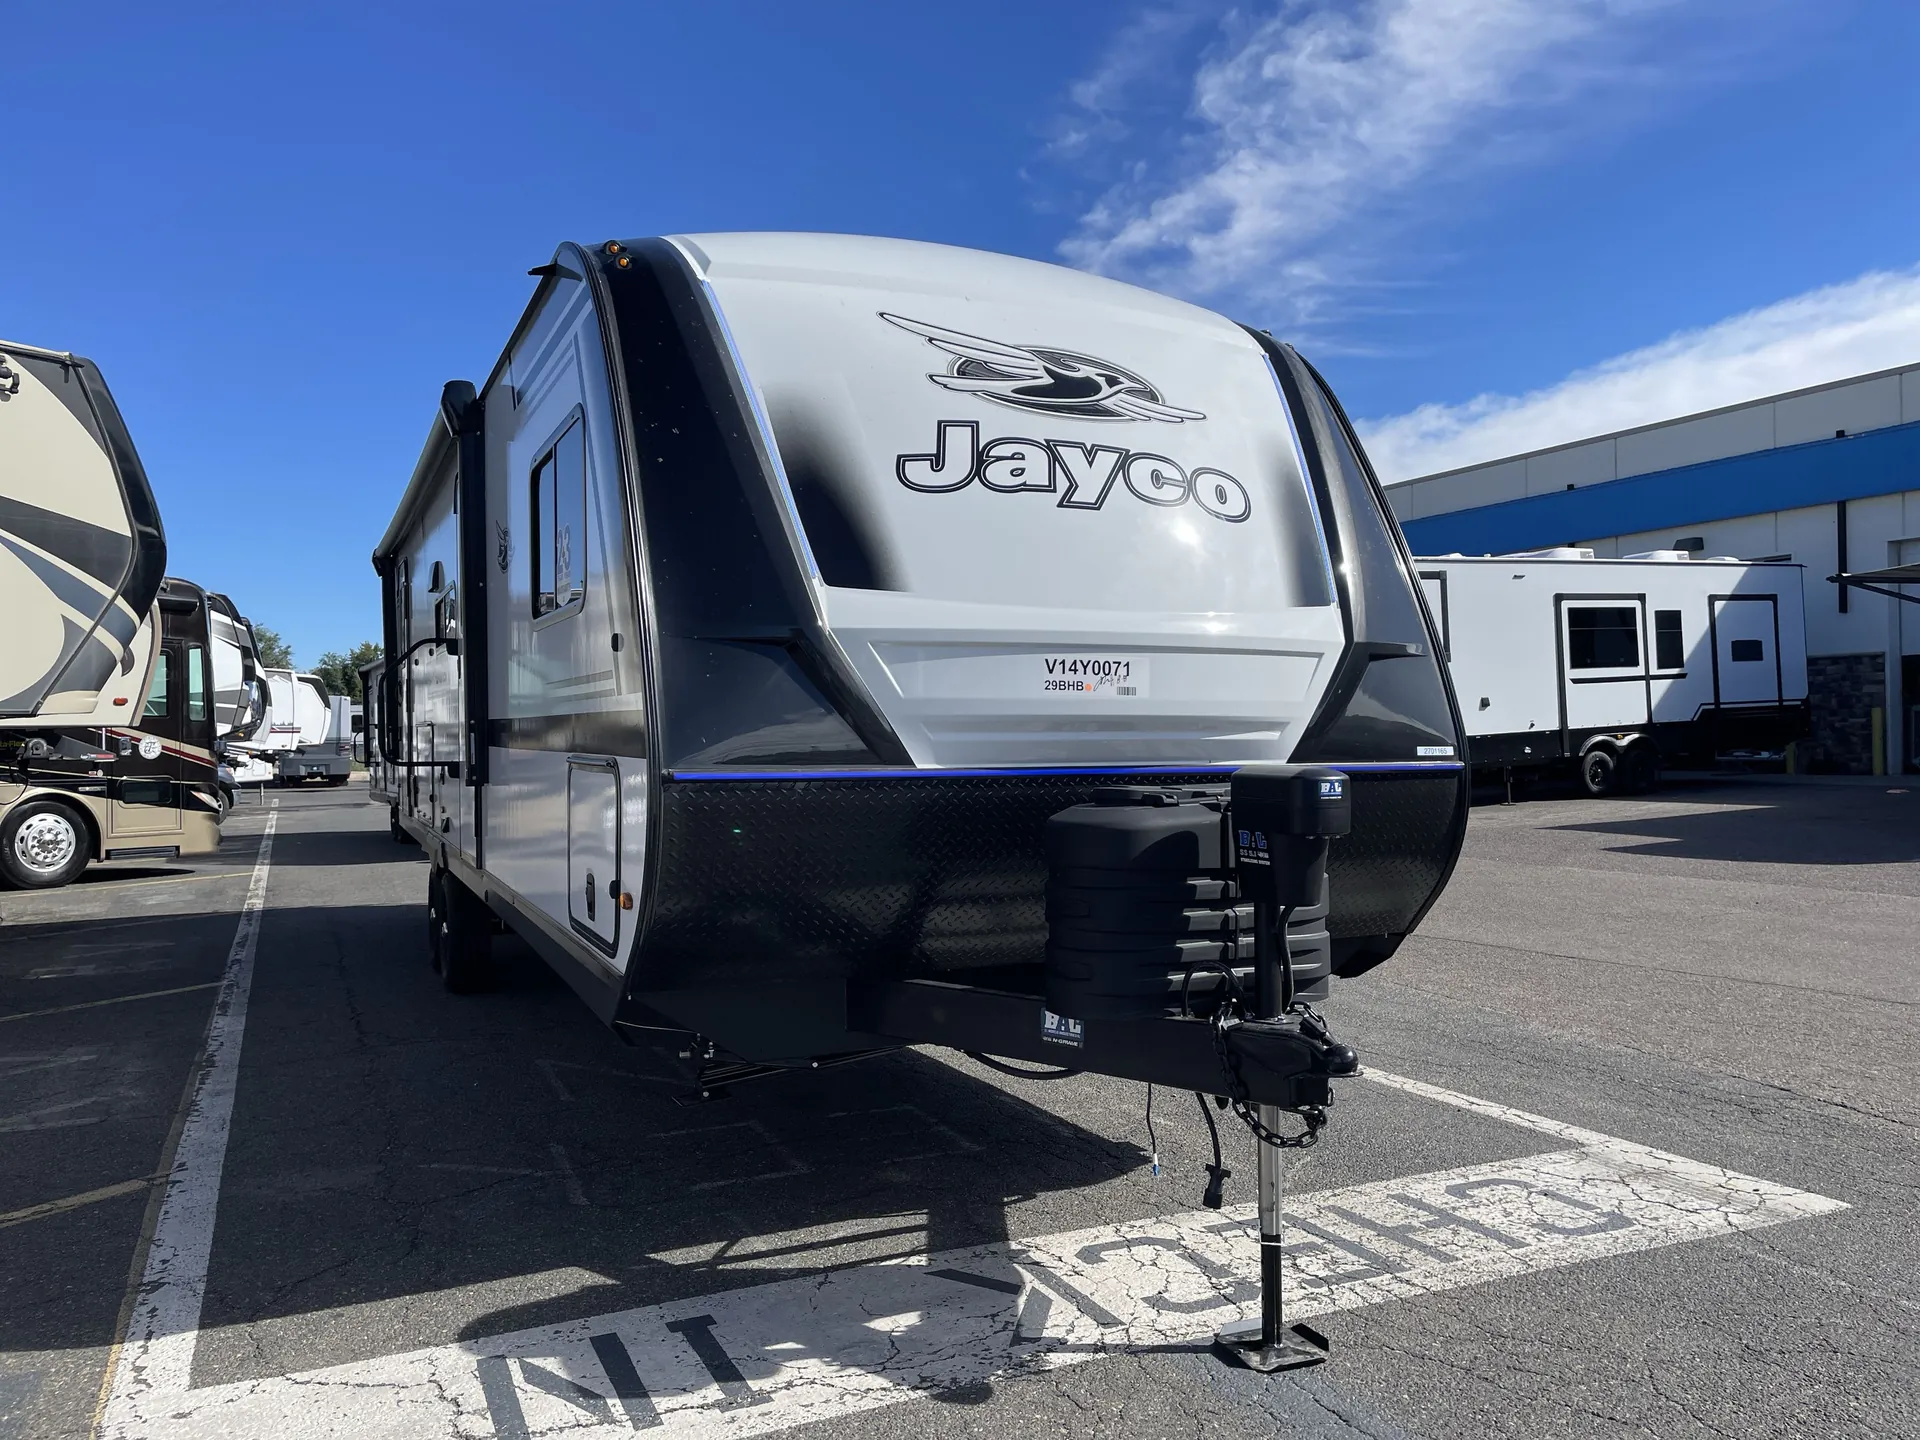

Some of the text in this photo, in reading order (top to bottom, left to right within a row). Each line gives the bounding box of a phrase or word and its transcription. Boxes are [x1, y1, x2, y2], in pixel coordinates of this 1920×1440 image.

[895, 419, 1252, 523] Jayco
[1045, 658, 1130, 676] V14Y0071
[1044, 680, 1084, 691] 29BHB
[1423, 747, 1448, 755] 2701165
[1044, 1010, 1081, 1034] BAL
[476, 1177, 1635, 1440] CHECK IN
